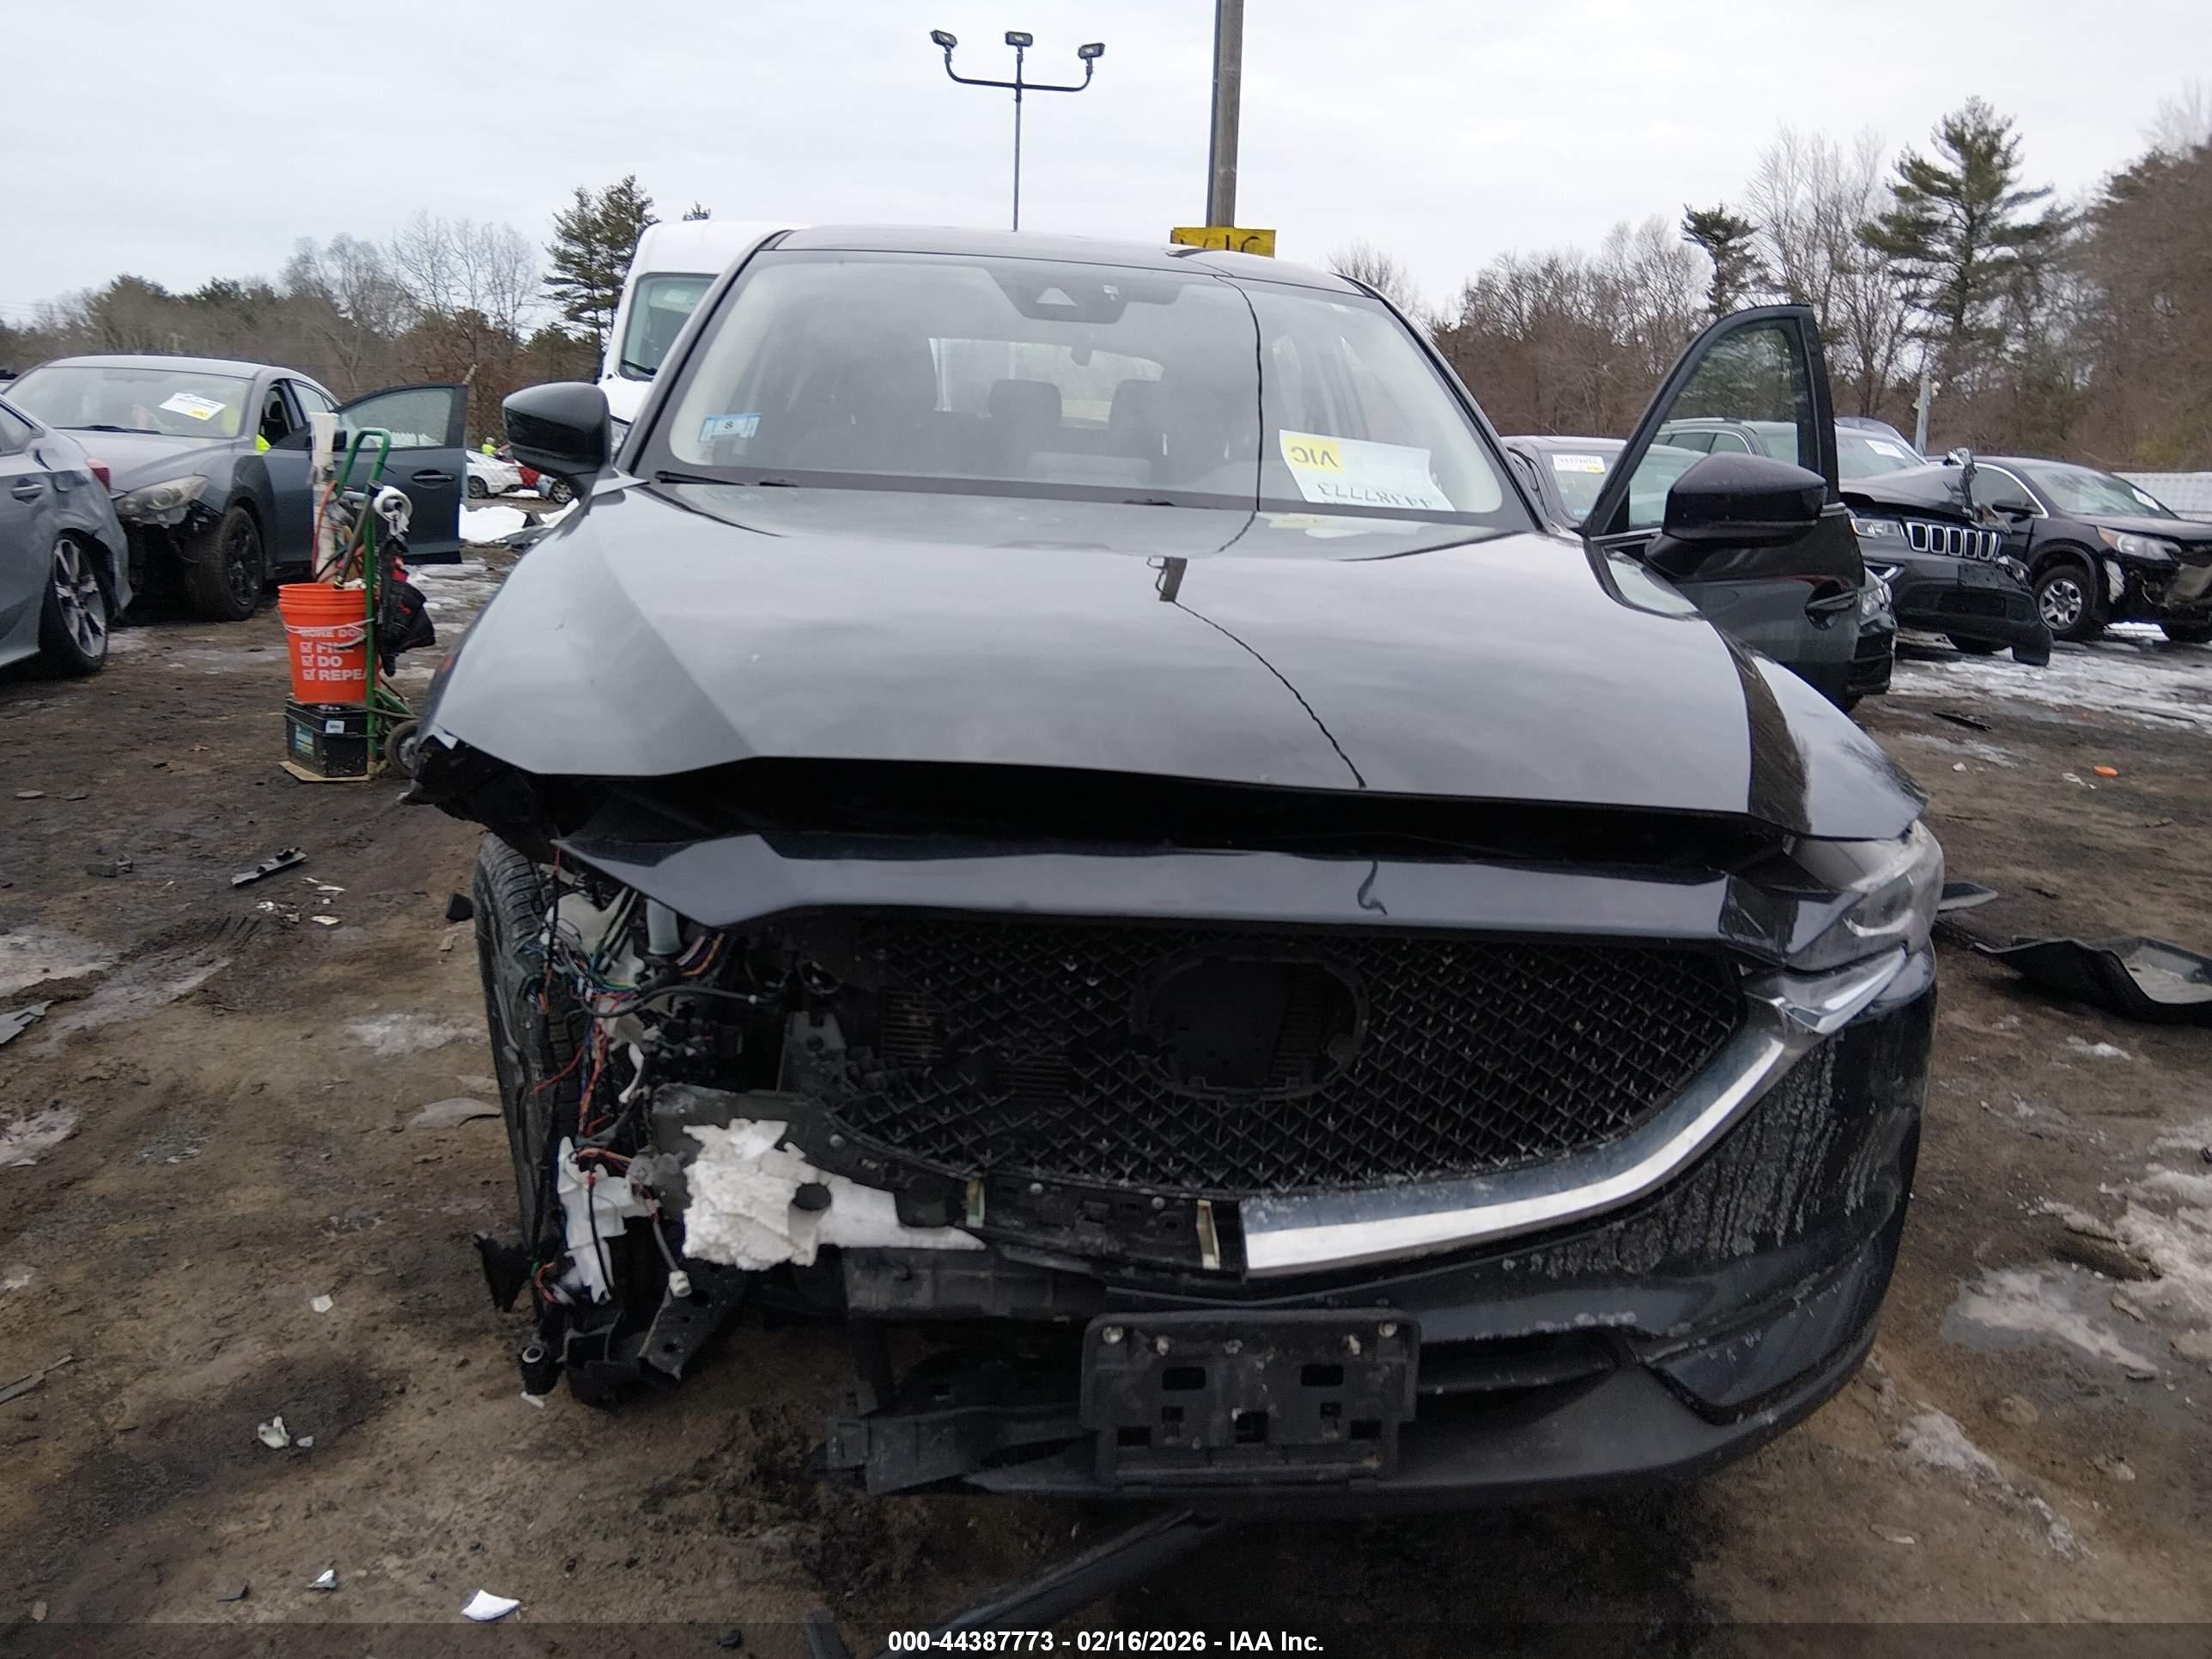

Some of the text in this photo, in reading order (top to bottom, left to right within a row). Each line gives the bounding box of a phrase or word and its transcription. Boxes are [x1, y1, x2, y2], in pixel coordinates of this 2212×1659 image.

[1291, 447, 1338, 468] VIC
[318, 656, 343, 667] DO
[319, 669, 366, 681] REPE
